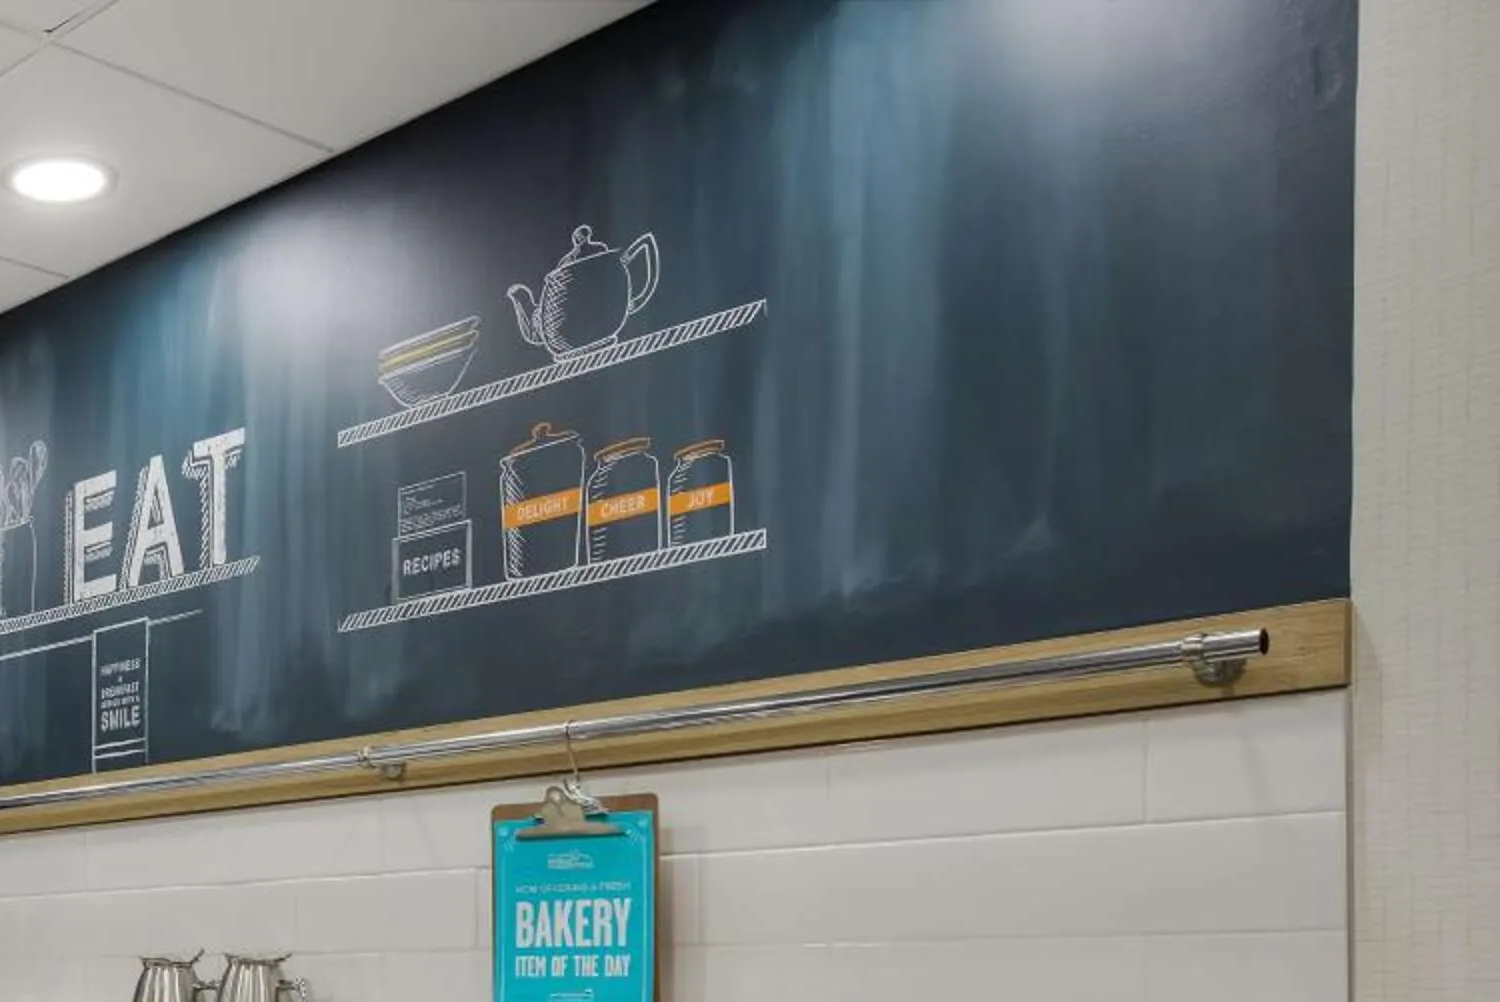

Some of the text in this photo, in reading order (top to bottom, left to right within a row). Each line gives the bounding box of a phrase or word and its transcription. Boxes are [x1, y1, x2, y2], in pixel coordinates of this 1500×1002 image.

[516, 496, 569, 521] DELIGHT
[600, 494, 646, 518] CHEER
[686, 488, 714, 509] JOY
[64, 427, 245, 604] EAT
[403, 547, 461, 576] RECIPES
[101, 705, 141, 733] SMILE
[515, 897, 632, 949] BAKERY
[515, 954, 632, 978] ITEM OF THE DAY
